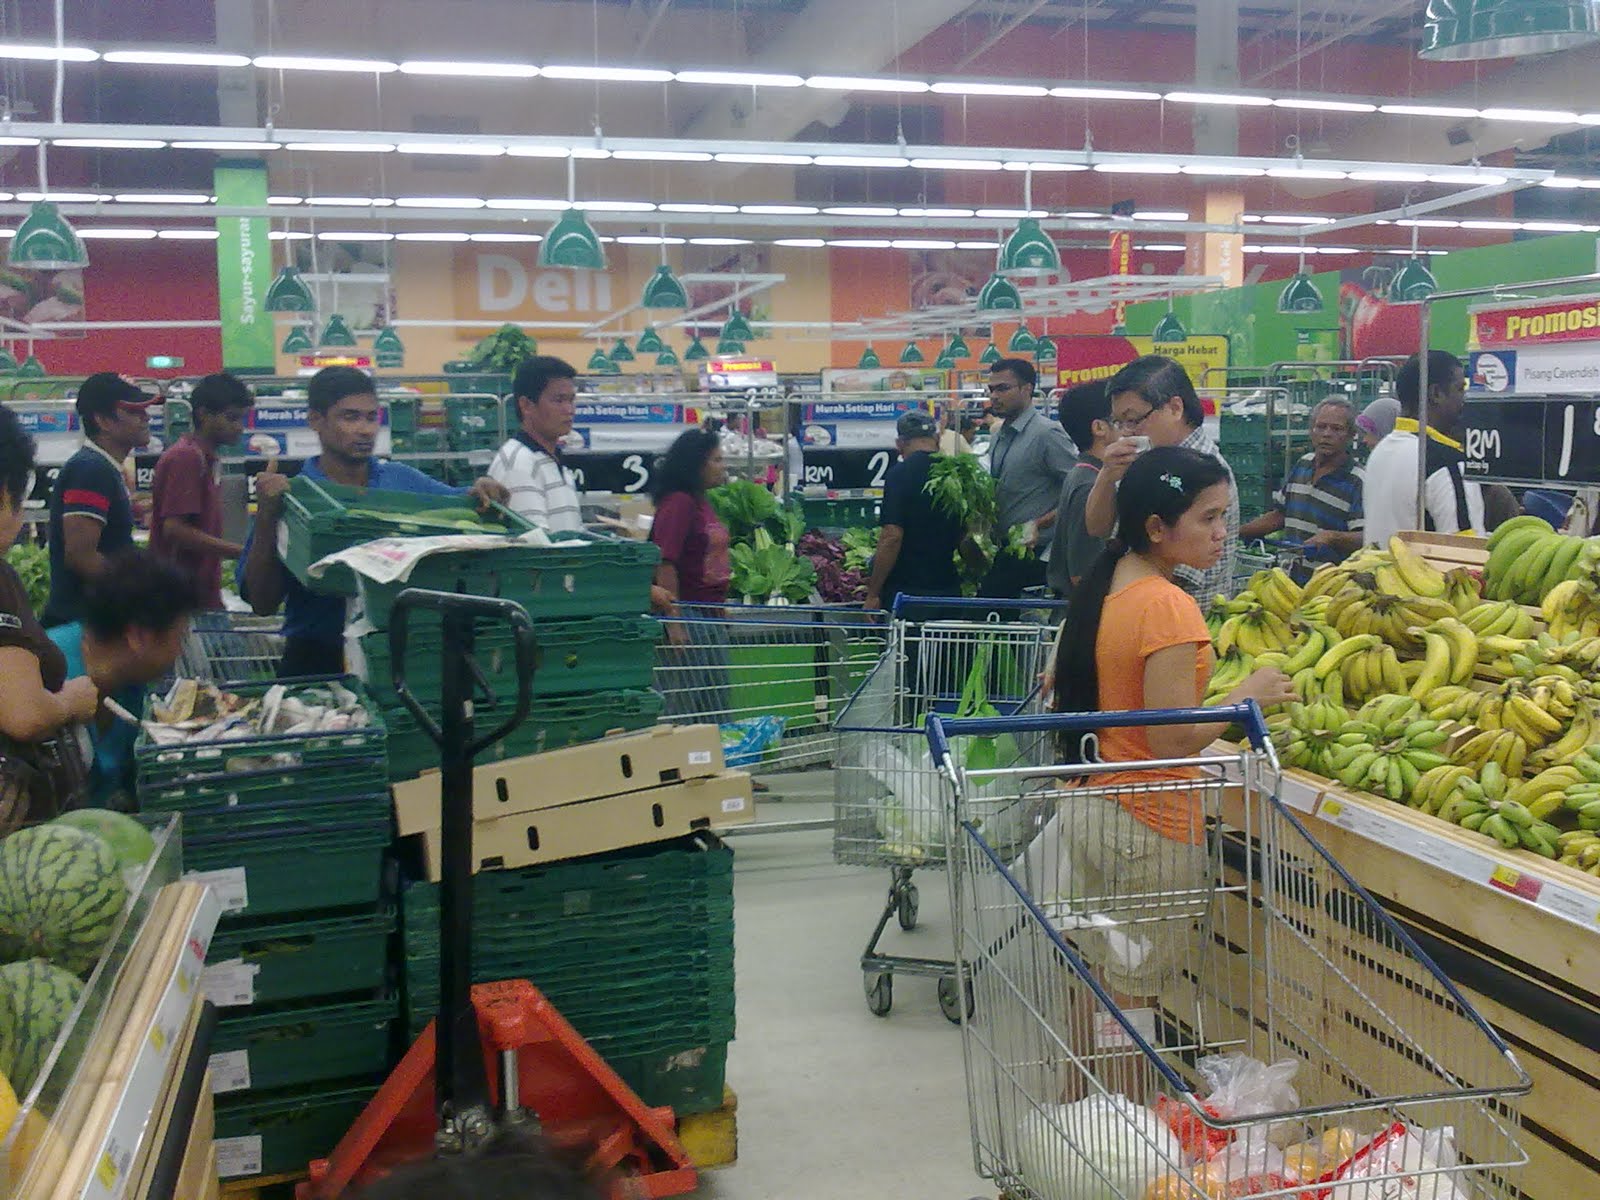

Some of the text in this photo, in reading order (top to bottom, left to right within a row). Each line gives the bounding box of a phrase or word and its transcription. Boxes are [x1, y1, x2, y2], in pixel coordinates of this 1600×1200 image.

[477, 254, 612, 313] Deli
[1154, 344, 1218, 356] Harga Hebat
[1060, 362, 1129, 385] Promo
[1524, 367, 1552, 381] Pisang
[1553, 365, 1600, 379] Cavendish
[257, 410, 293, 420] Murah
[595, 406, 626, 417] Setiap
[628, 406, 649, 415] Hari
[815, 403, 895, 414] Murah Setiap Hari
[1465, 427, 1501, 459] RM
[1558, 404, 1575, 477] 1
[622, 455, 649, 492] 3
[805, 451, 890, 487] RM 2
